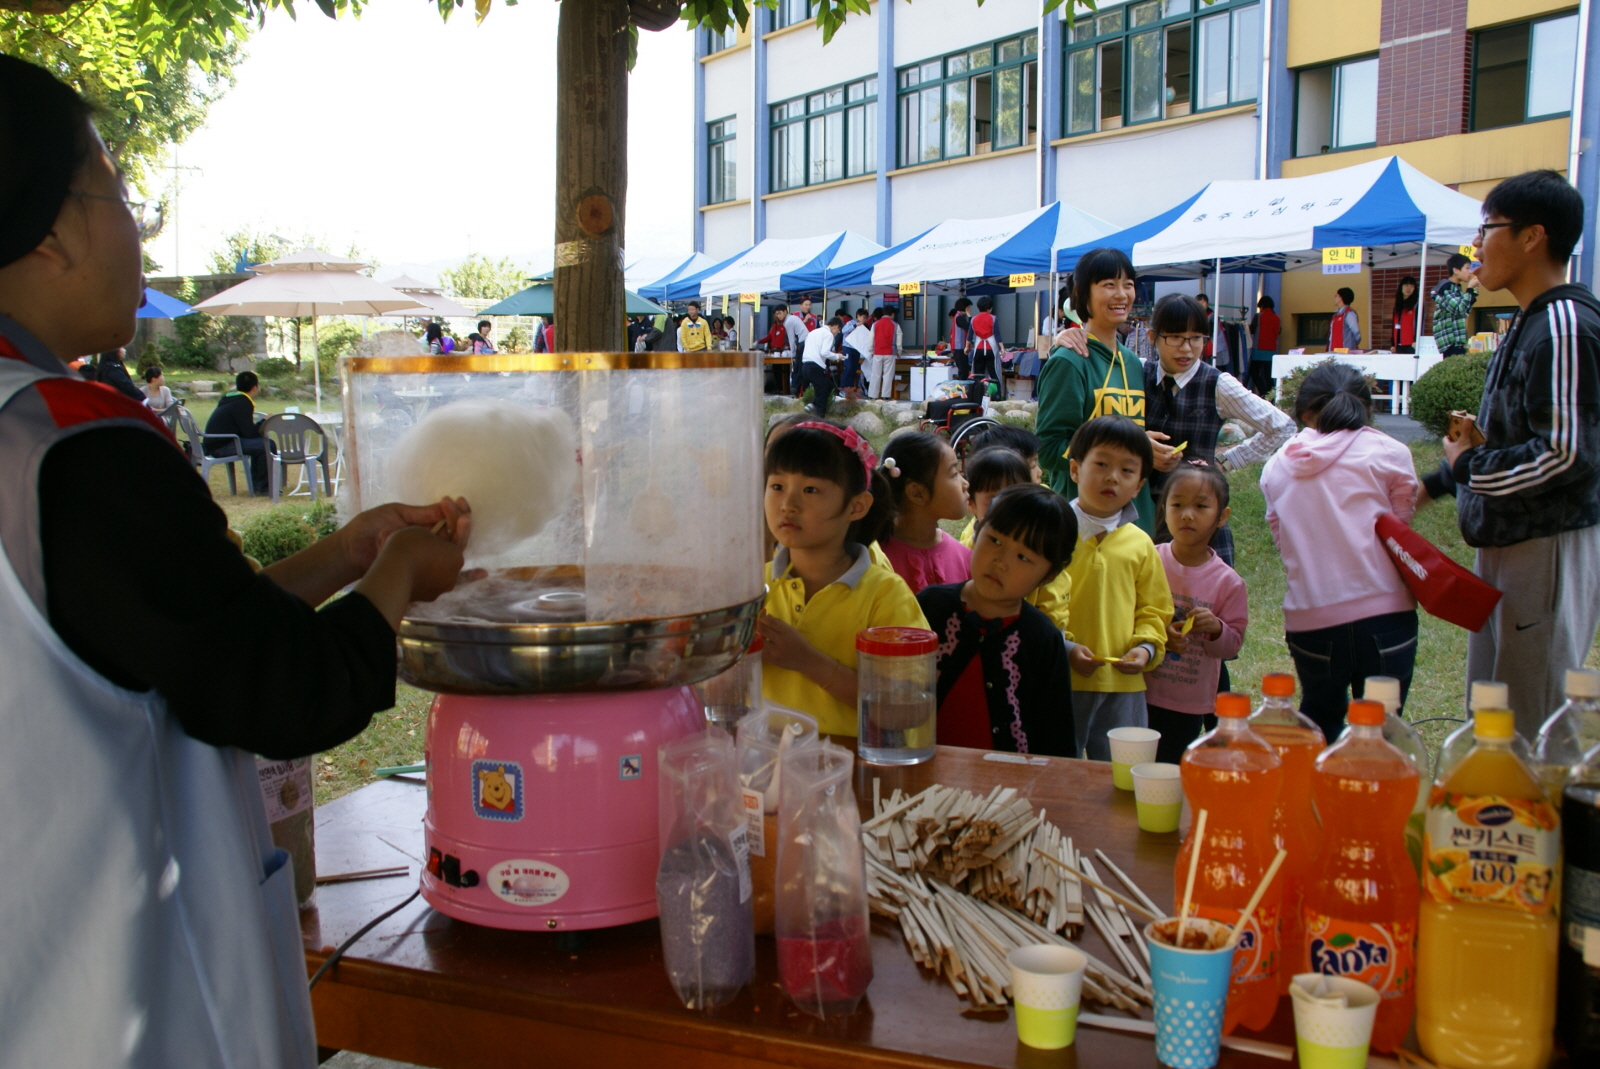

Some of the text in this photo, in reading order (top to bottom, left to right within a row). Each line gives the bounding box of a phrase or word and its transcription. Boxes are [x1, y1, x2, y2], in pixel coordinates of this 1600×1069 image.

[1328, 248, 1356, 261] 안내
[1450, 827, 1537, 856] 썬키스트
[1471, 861, 1517, 885] 100
[1311, 939, 1388, 976] Fanta
